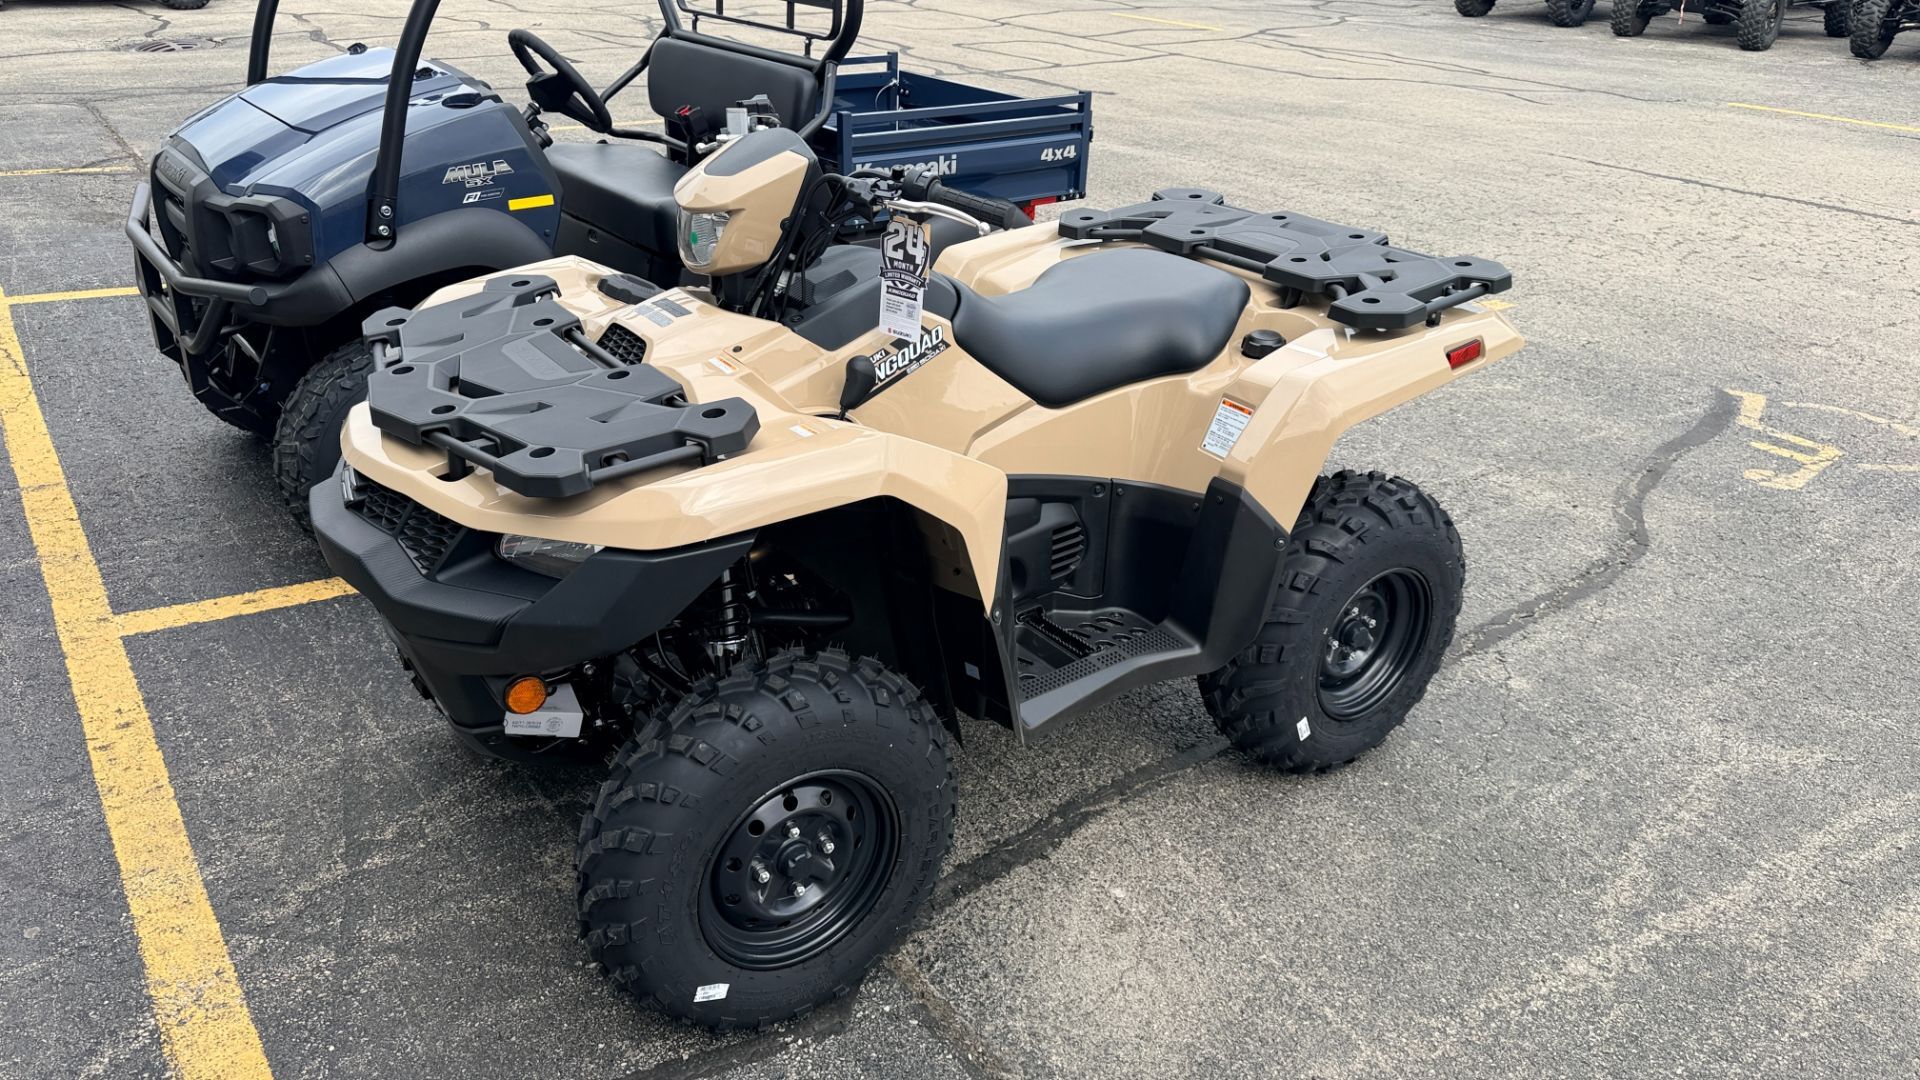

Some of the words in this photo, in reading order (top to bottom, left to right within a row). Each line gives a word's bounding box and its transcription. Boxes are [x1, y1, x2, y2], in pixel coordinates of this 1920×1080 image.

[1040, 145, 1077, 162] 4x4
[442, 159, 515, 185] MULE
[465, 175, 494, 189] SX
[886, 220, 925, 265] 24
[893, 259, 914, 272] MONTH
[884, 271, 901, 279] LIMITED
[901, 273, 922, 287] WARRANTY
[888, 288, 916, 299] KINGQUAD
[892, 329, 913, 339] SUZUKI
[869, 349, 886, 364] UKI
[874, 325, 944, 384] NGQUAD
